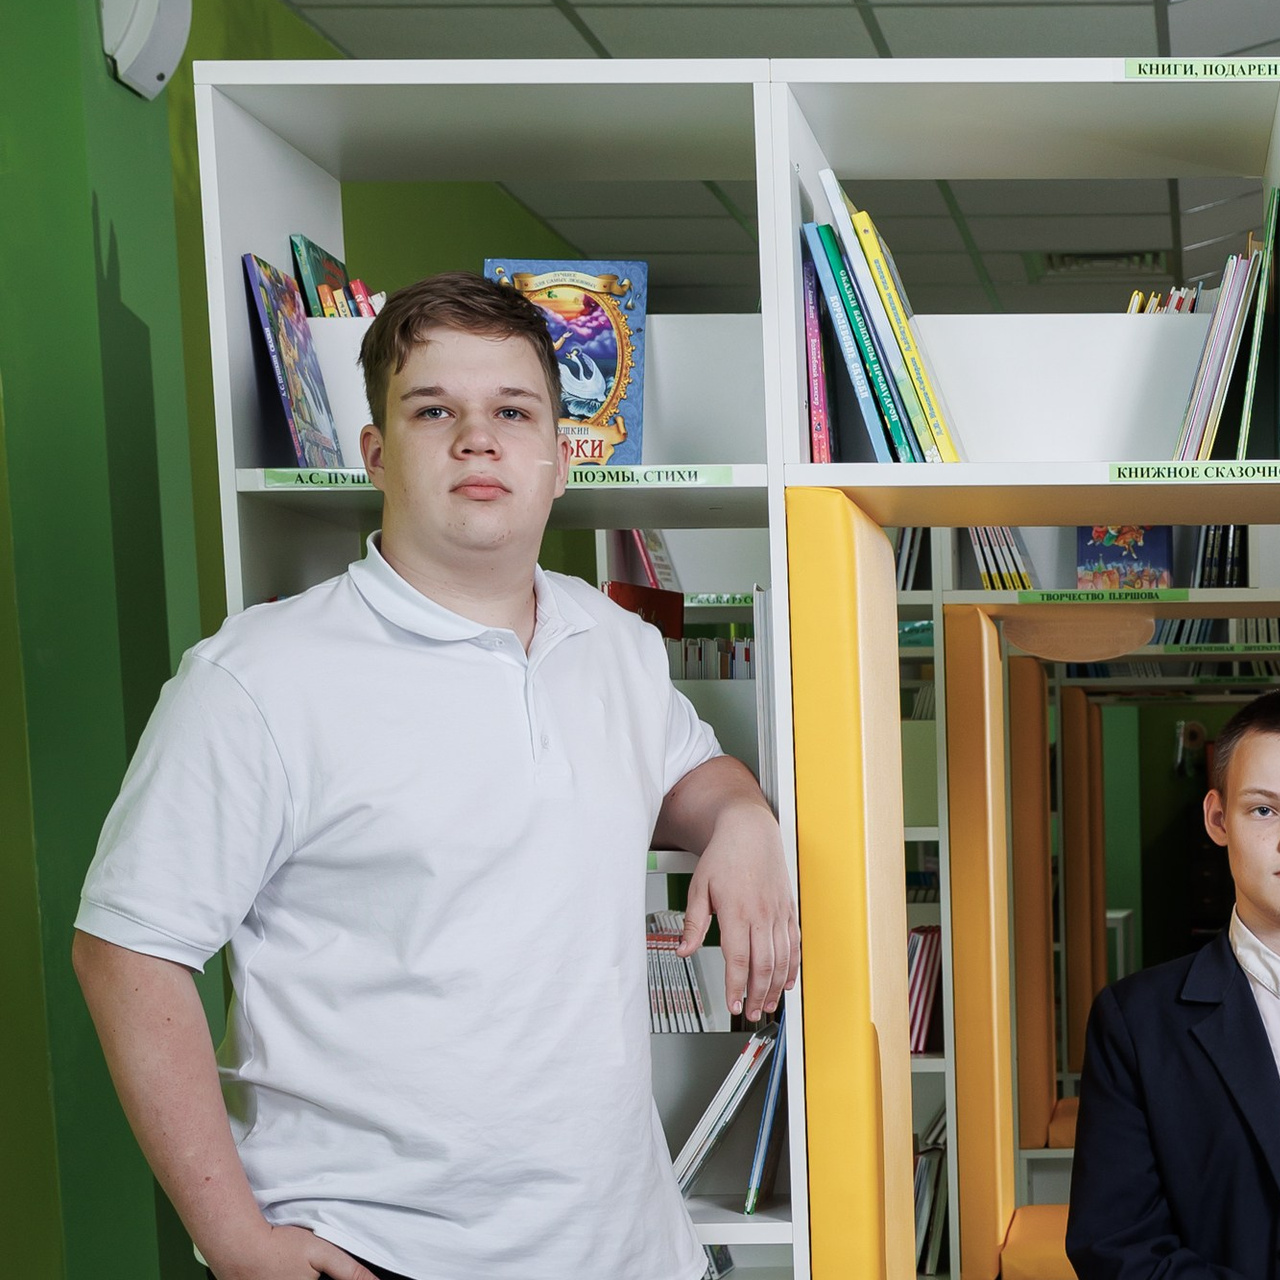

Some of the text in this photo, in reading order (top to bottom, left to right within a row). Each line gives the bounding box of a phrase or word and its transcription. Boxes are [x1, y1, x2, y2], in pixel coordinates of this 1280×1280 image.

[1138, 63, 1198, 77] КНИГИ,
[829, 295, 869, 399] КОРОЛЕВСКИЕ СКАЗКИ
[839, 270, 899, 422] СКАЗКИ ВАСИЛИСЫ ПРЕМУДРОЙ
[295, 473, 372, 484] А.С. ПУШ
[573, 470, 698, 484] ПОЭМЫ, СТИХИ
[1117, 466, 1200, 479] КНИЖНОЕ
[1040, 592, 1159, 601] ТВОРЧЕСТВО П.ЕРШОВА
